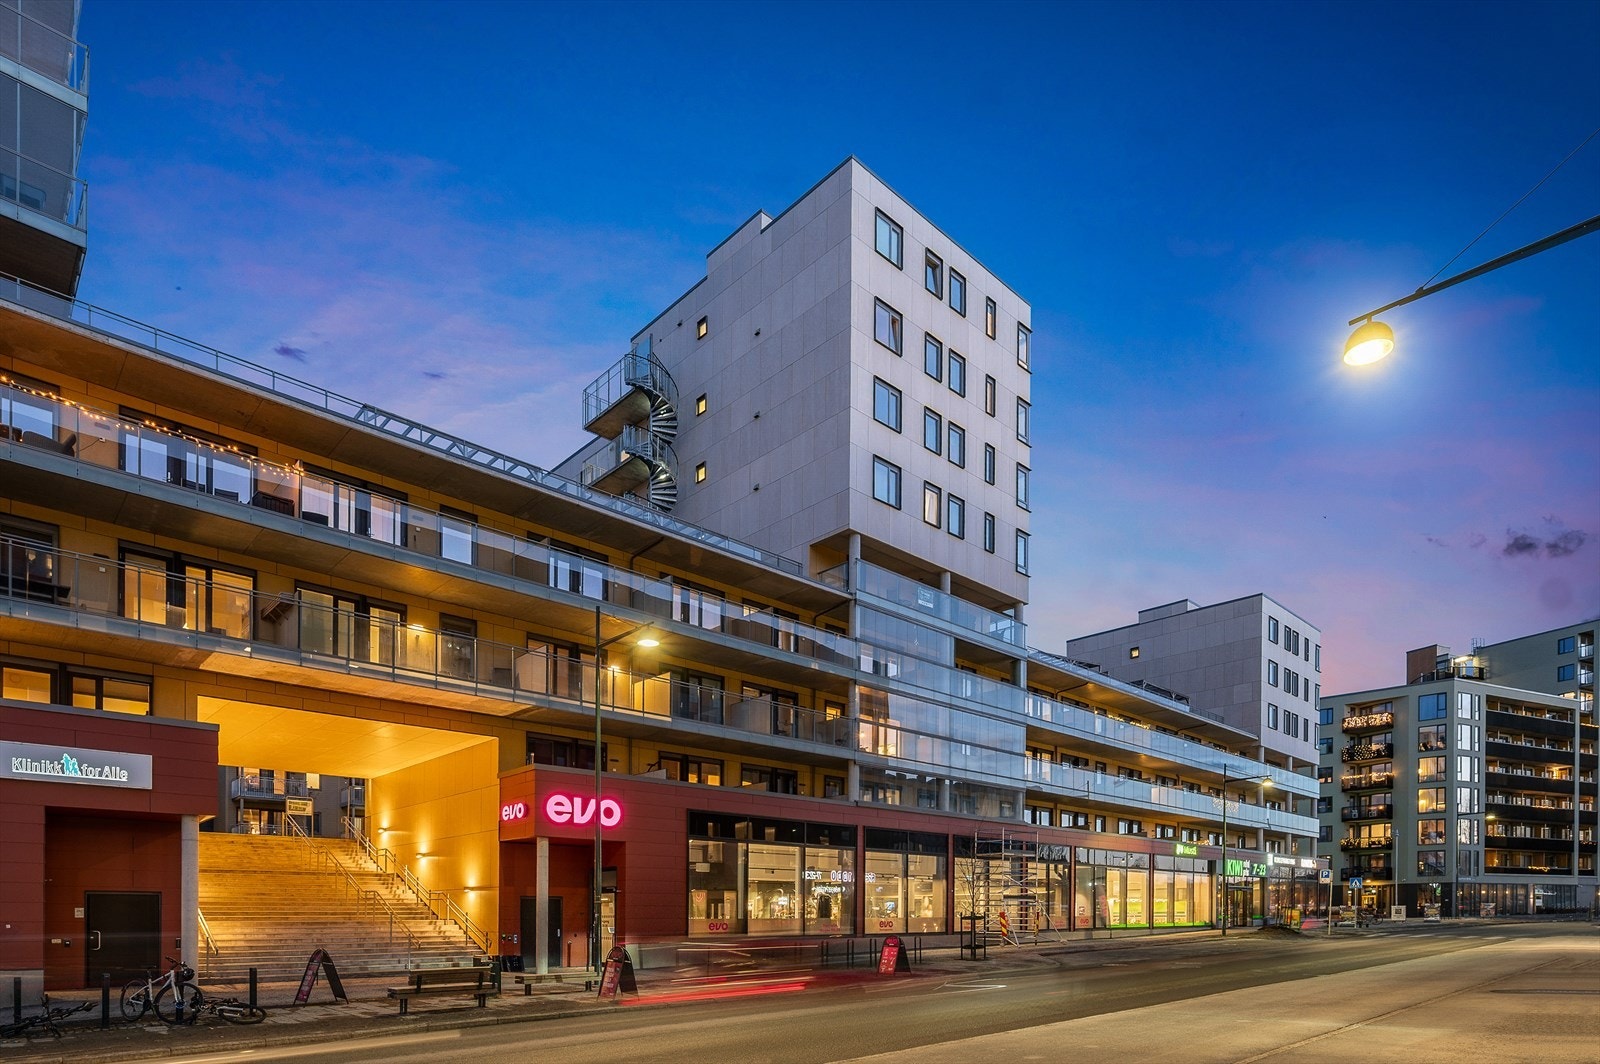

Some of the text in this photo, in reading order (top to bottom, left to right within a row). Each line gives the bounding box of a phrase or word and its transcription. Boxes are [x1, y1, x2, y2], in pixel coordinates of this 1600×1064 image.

[11, 757, 128, 780] Klinikk for Alle
[502, 802, 524, 821] evo
[546, 794, 621, 826] evo
[1227, 859, 1243, 876] KIWI
[708, 922, 729, 931] evo
[879, 920, 893, 928] evo
